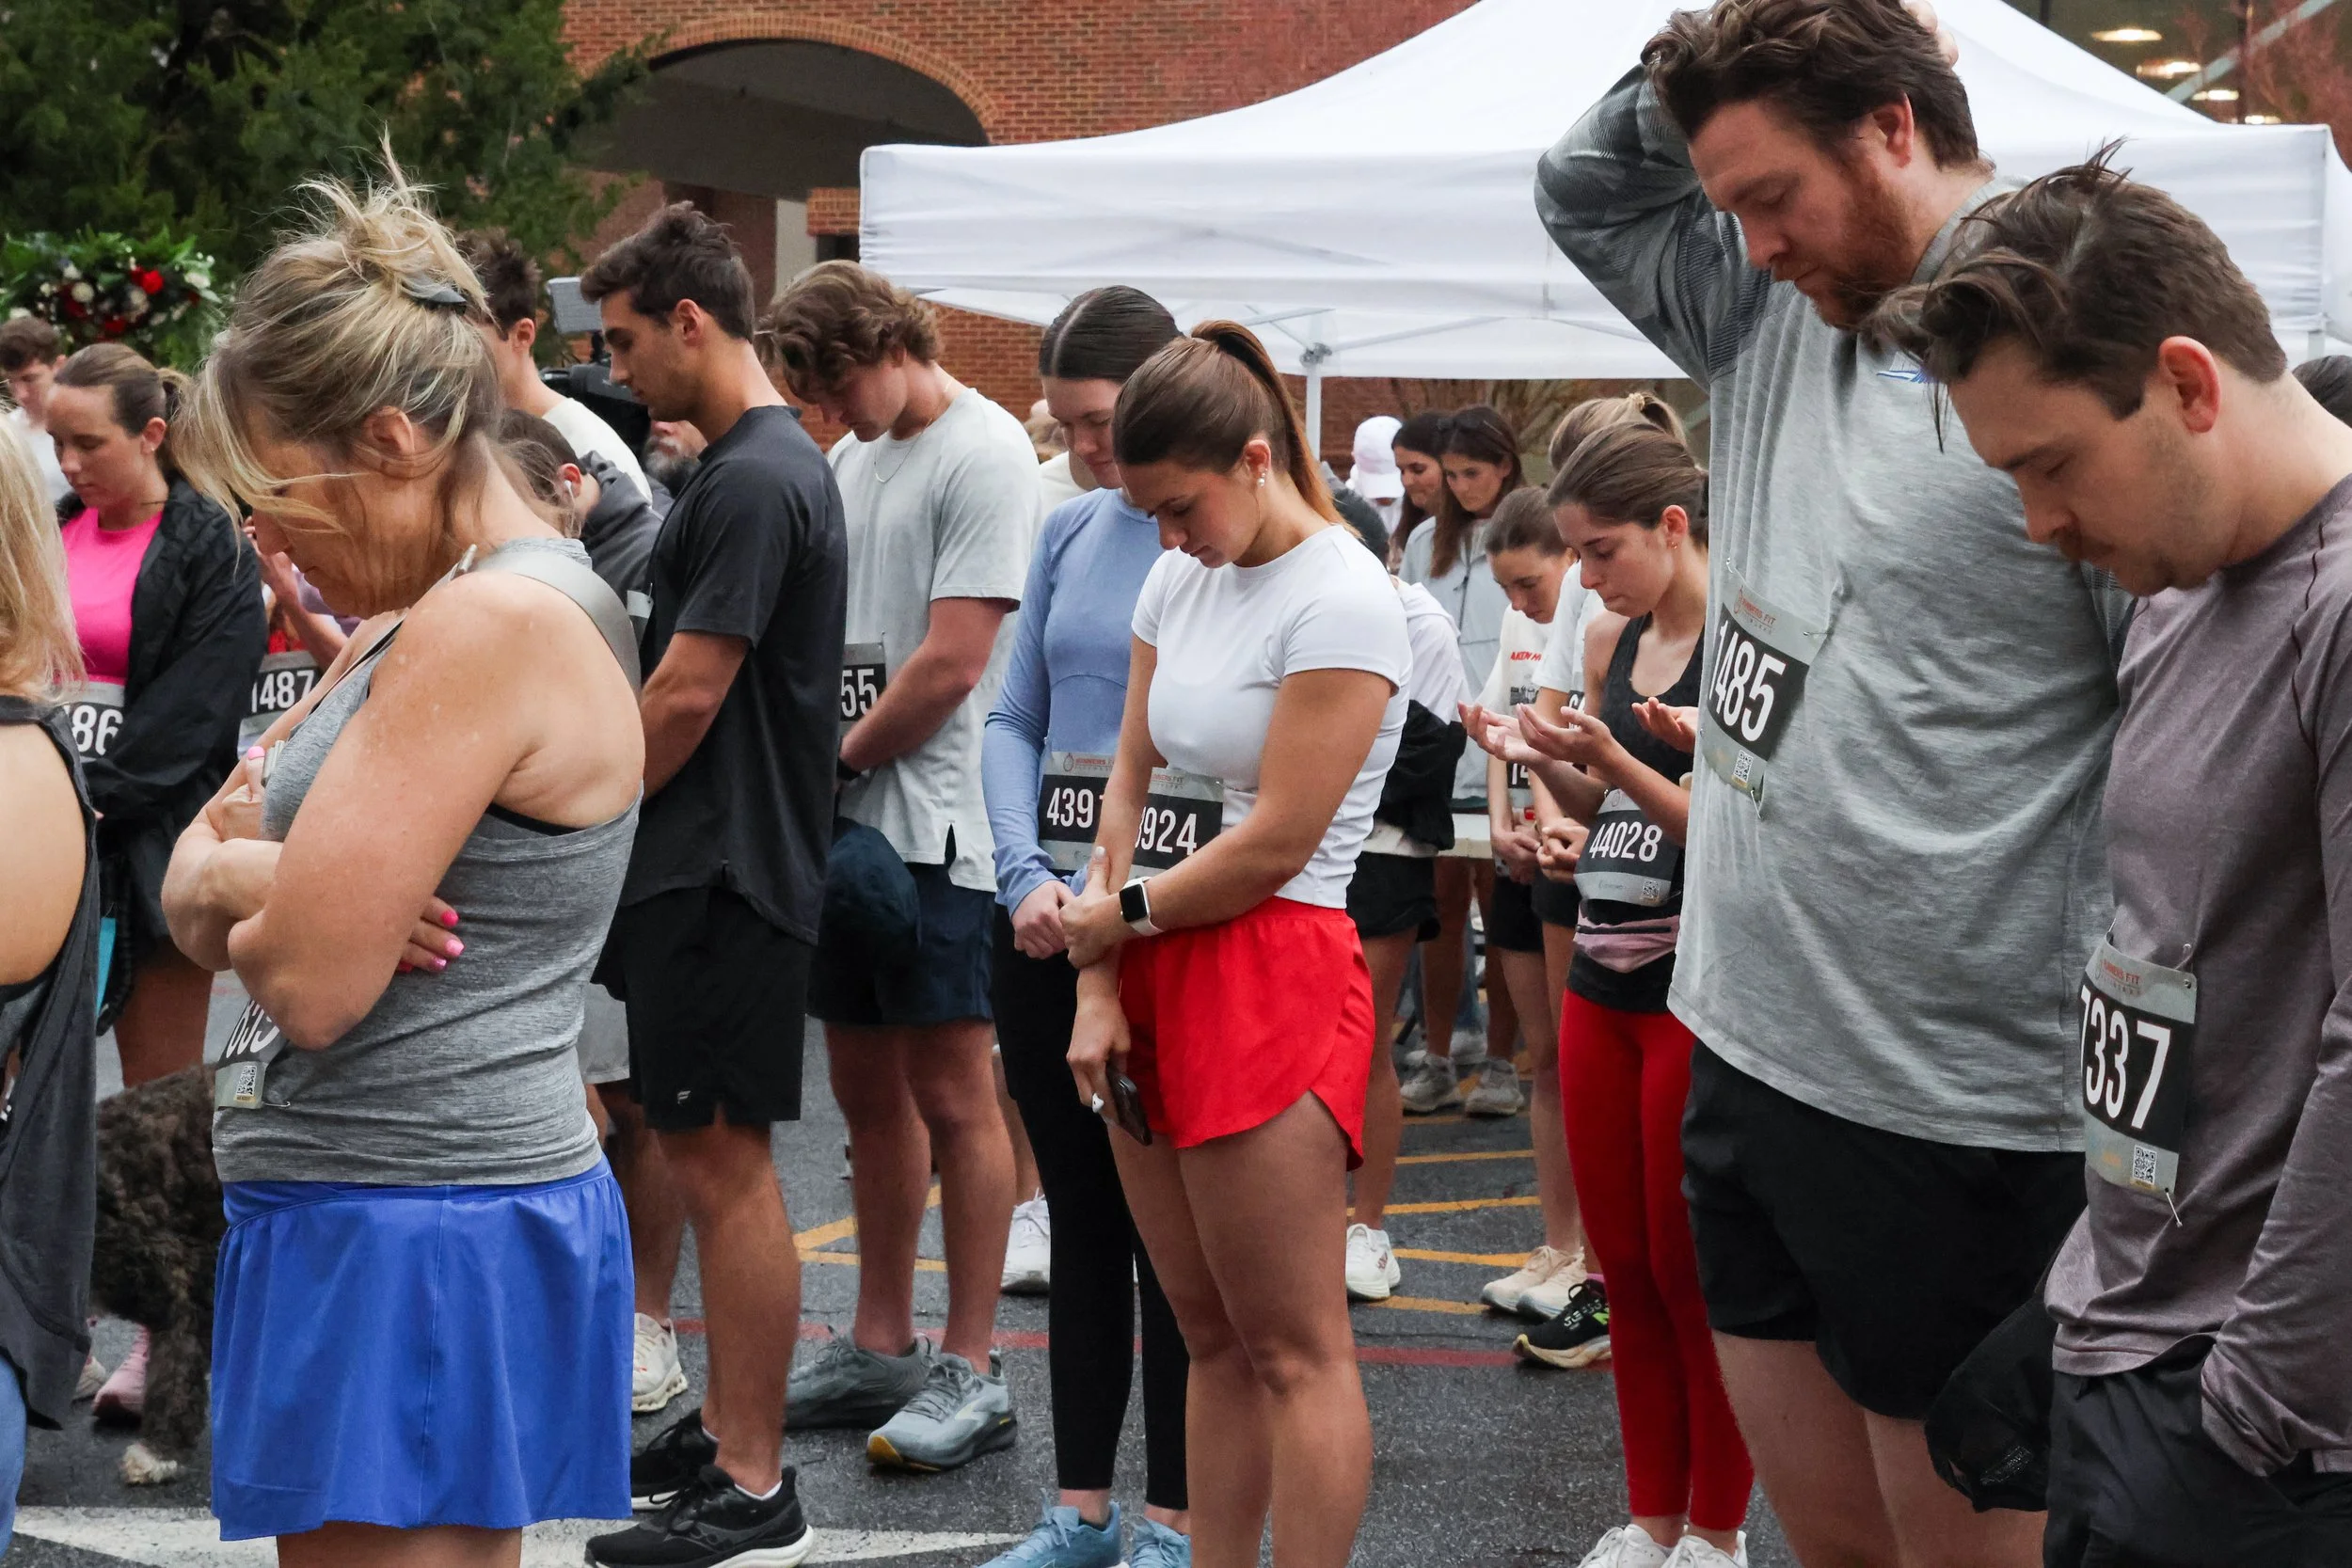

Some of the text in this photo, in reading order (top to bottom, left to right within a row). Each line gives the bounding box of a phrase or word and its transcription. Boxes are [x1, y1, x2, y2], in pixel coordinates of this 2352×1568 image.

[840, 669, 878, 718] 55
[1709, 620, 1786, 741] 1485
[64, 705, 123, 755] 86
[1047, 787, 1104, 829] 439
[1589, 821, 1662, 863] 44028
